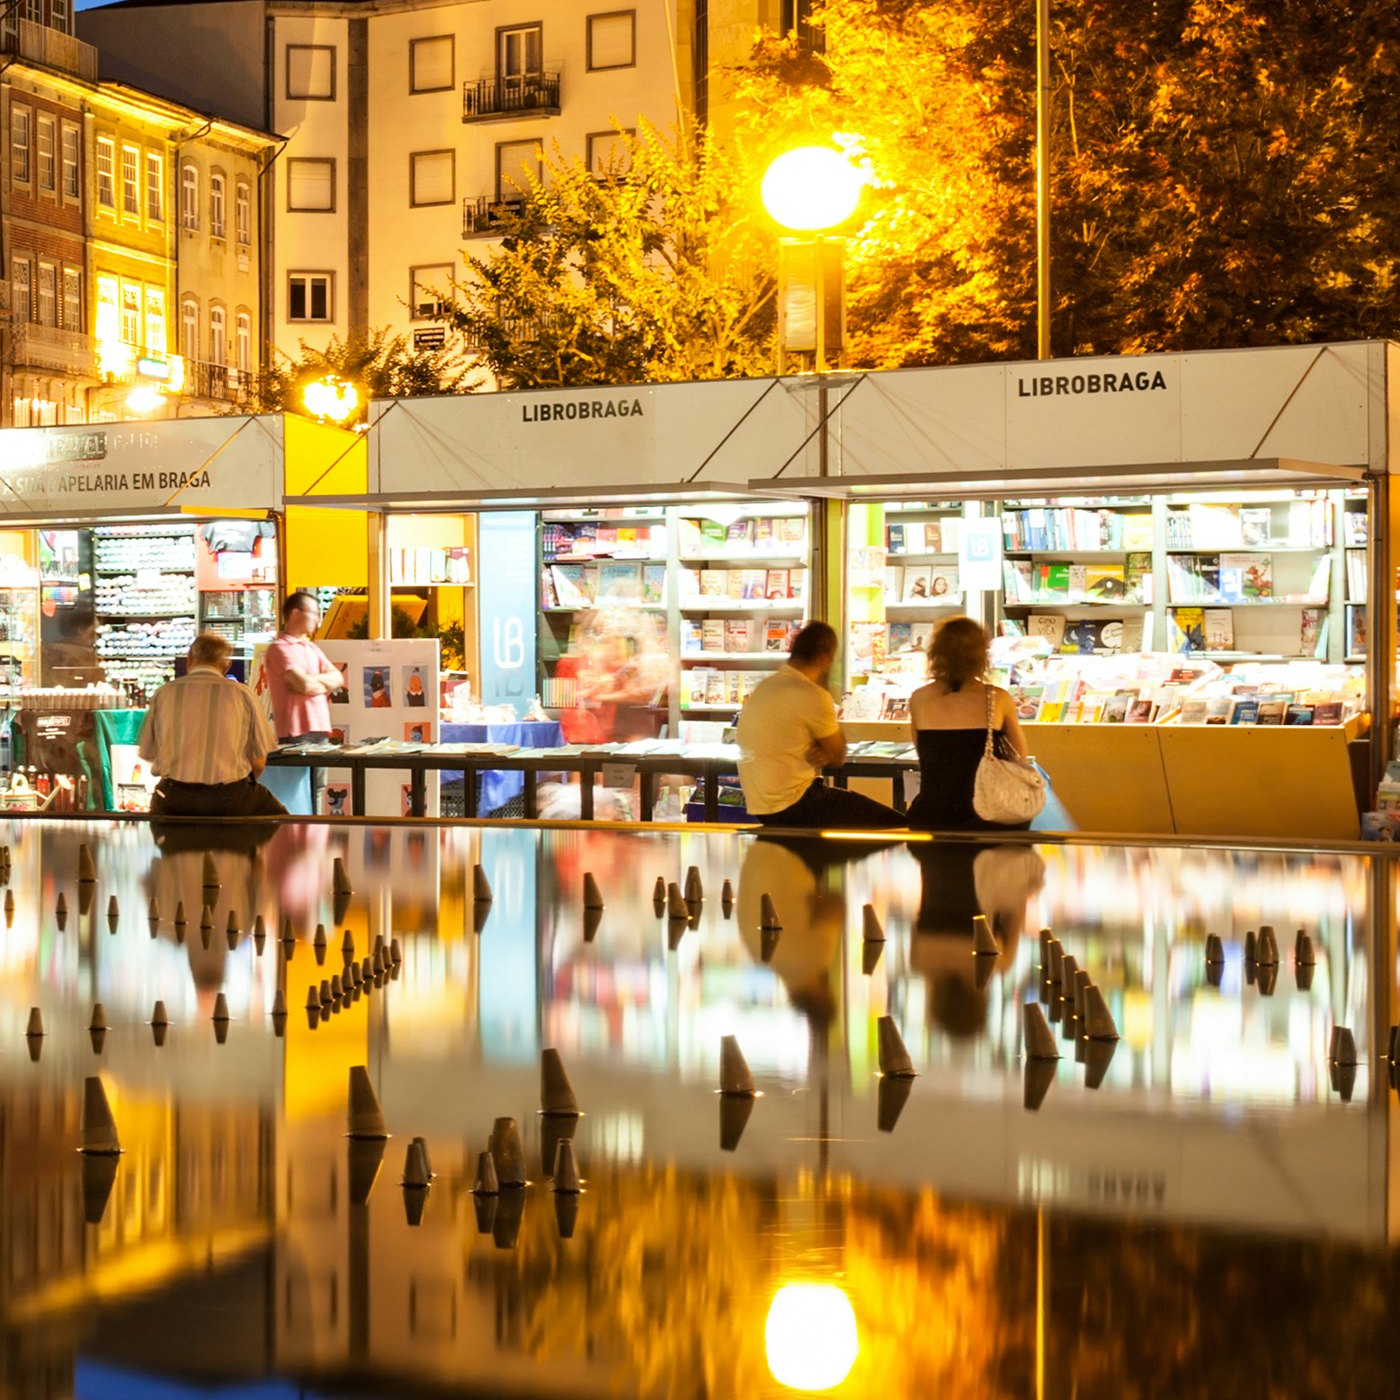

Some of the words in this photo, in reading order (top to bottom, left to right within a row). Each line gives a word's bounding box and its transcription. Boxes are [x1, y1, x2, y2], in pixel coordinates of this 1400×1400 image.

[1019, 371, 1167, 397] LIBROBRAGA
[523, 399, 644, 422] LIBROBRAGA
[133, 472, 155, 490] EM
[160, 470, 211, 490] BRAGA
